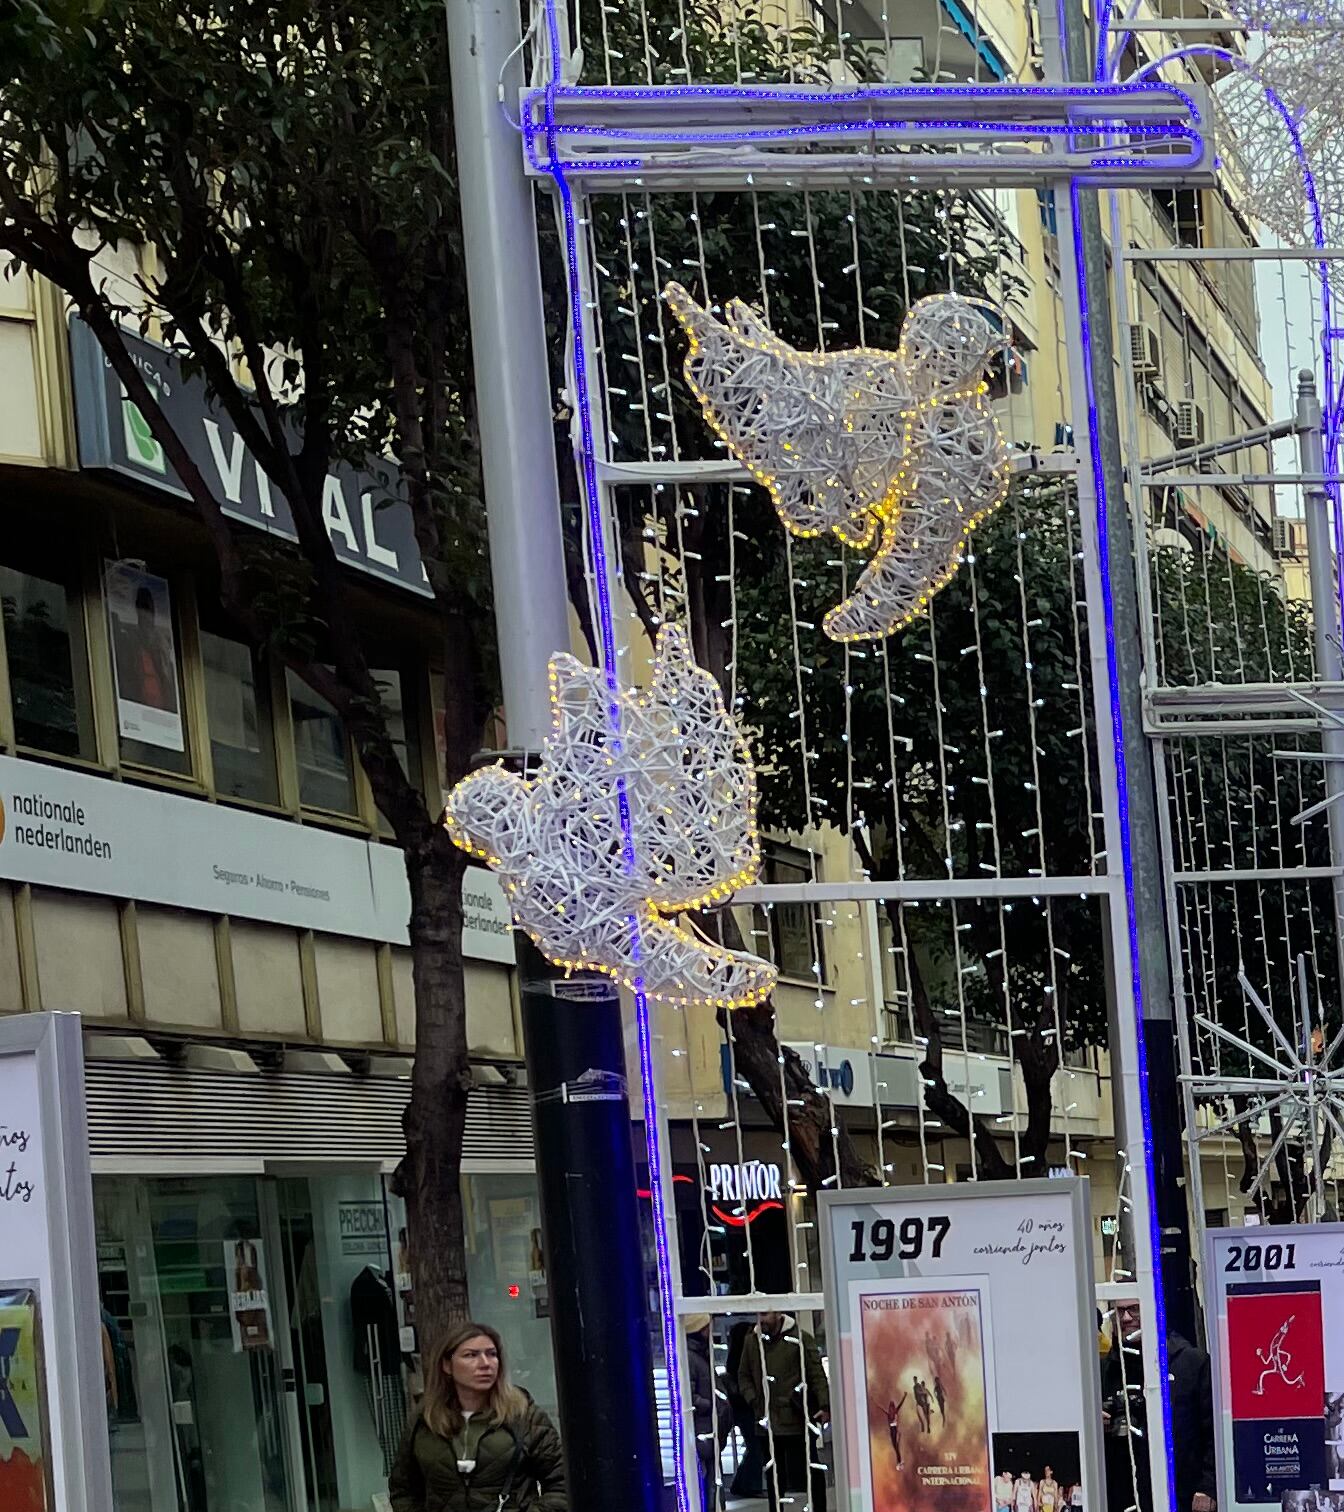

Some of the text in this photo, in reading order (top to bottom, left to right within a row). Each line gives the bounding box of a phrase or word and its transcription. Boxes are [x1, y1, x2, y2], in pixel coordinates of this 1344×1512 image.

[203, 417, 399, 572] VIAL
[13, 793, 85, 826] nationale
[15, 825, 112, 859] nederlanden
[710, 1163, 781, 1201] PRIMOR
[849, 1216, 951, 1262] 1997
[1018, 1219, 1065, 1233] 40 años
[1225, 1243, 1297, 1272] 2001
[863, 1294, 978, 1311] NOCHE DE SAN ANTÓN
